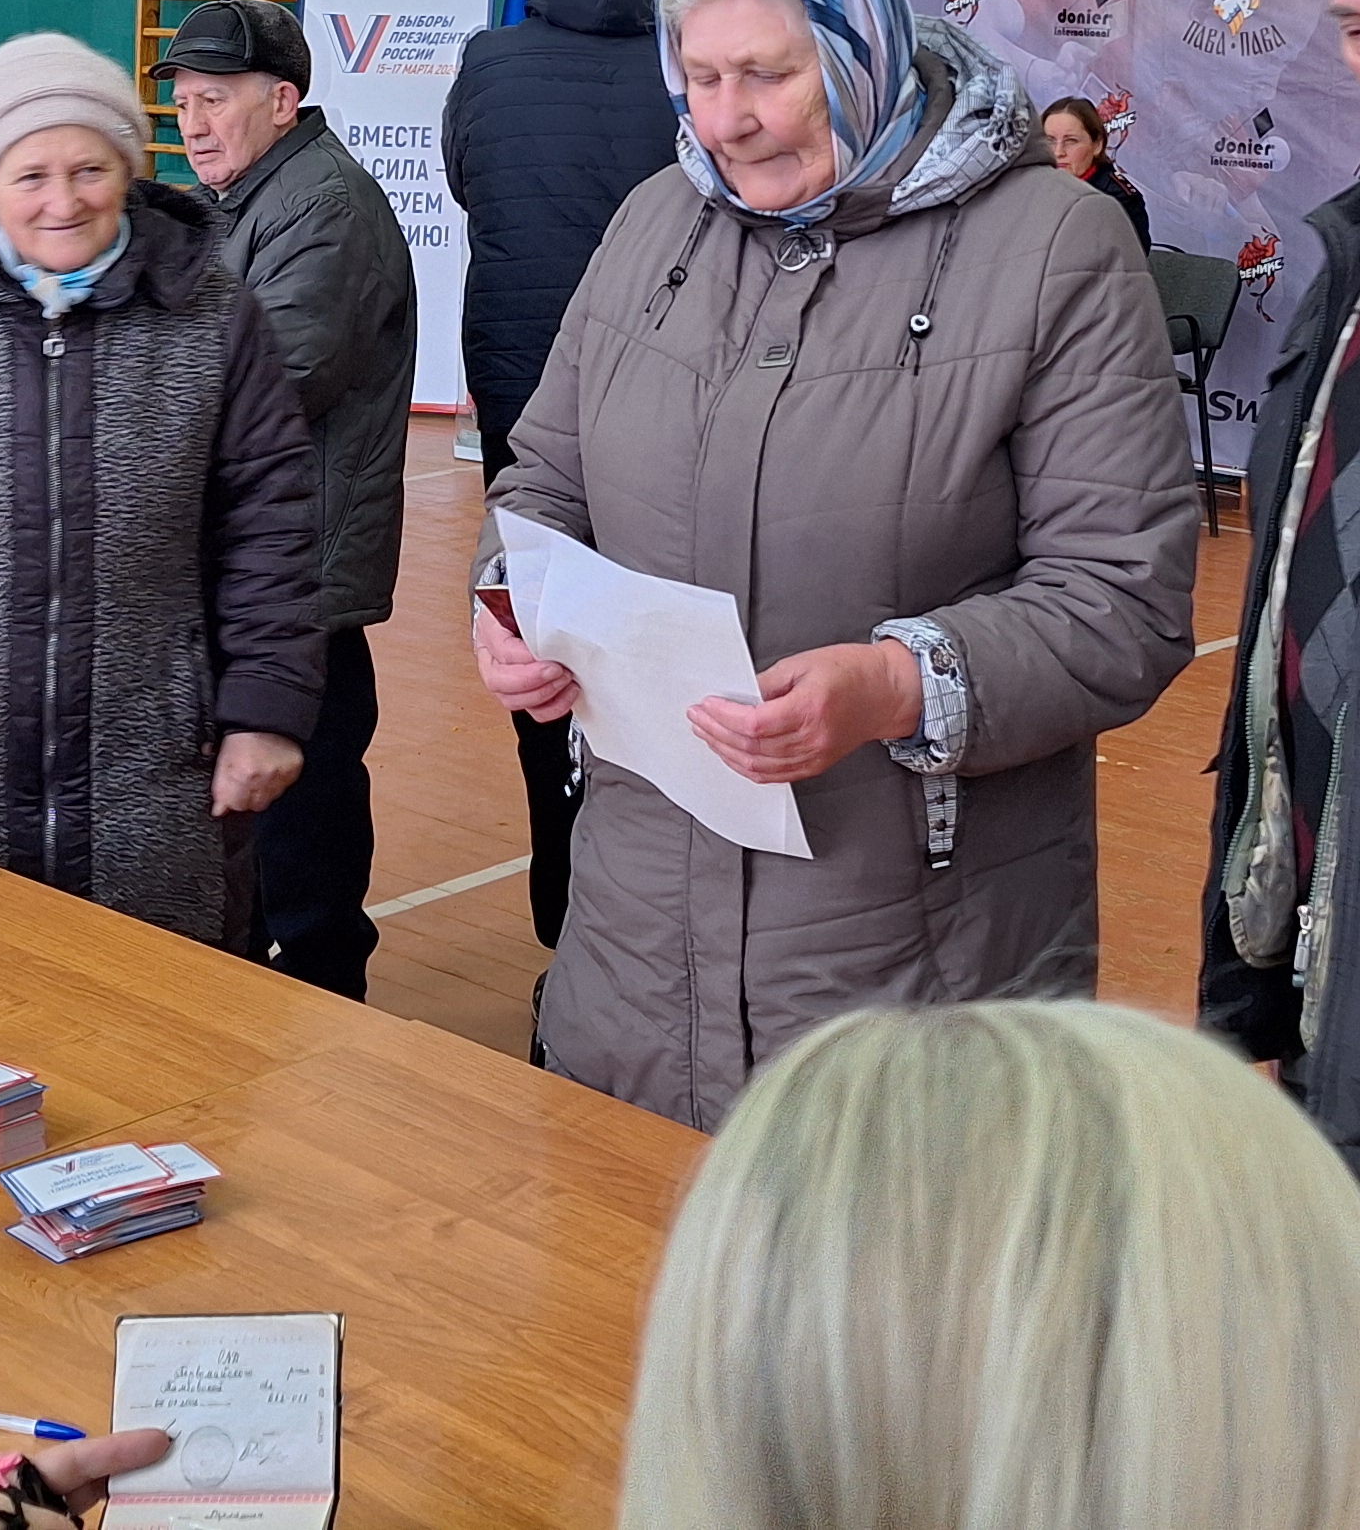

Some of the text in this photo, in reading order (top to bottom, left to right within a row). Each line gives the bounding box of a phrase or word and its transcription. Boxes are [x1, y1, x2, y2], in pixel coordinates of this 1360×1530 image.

[396, 15, 455, 27] ВЫБОРЫ
[1057, 8, 1110, 24] donier
[388, 31, 470, 45] ПРЕЗИДЕНТА
[1054, 27, 1111, 38] International
[381, 48, 435, 60] РОССИИ
[402, 64, 434, 74] МАРТА
[348, 125, 432, 148] ВМЕСТЕ
[1214, 137, 1272, 156] donier
[372, 158, 428, 181] СИЛА
[1210, 156, 1273, 169] International
[387, 191, 443, 214] СУЕМ
[401, 224, 450, 247] ИЮ!
